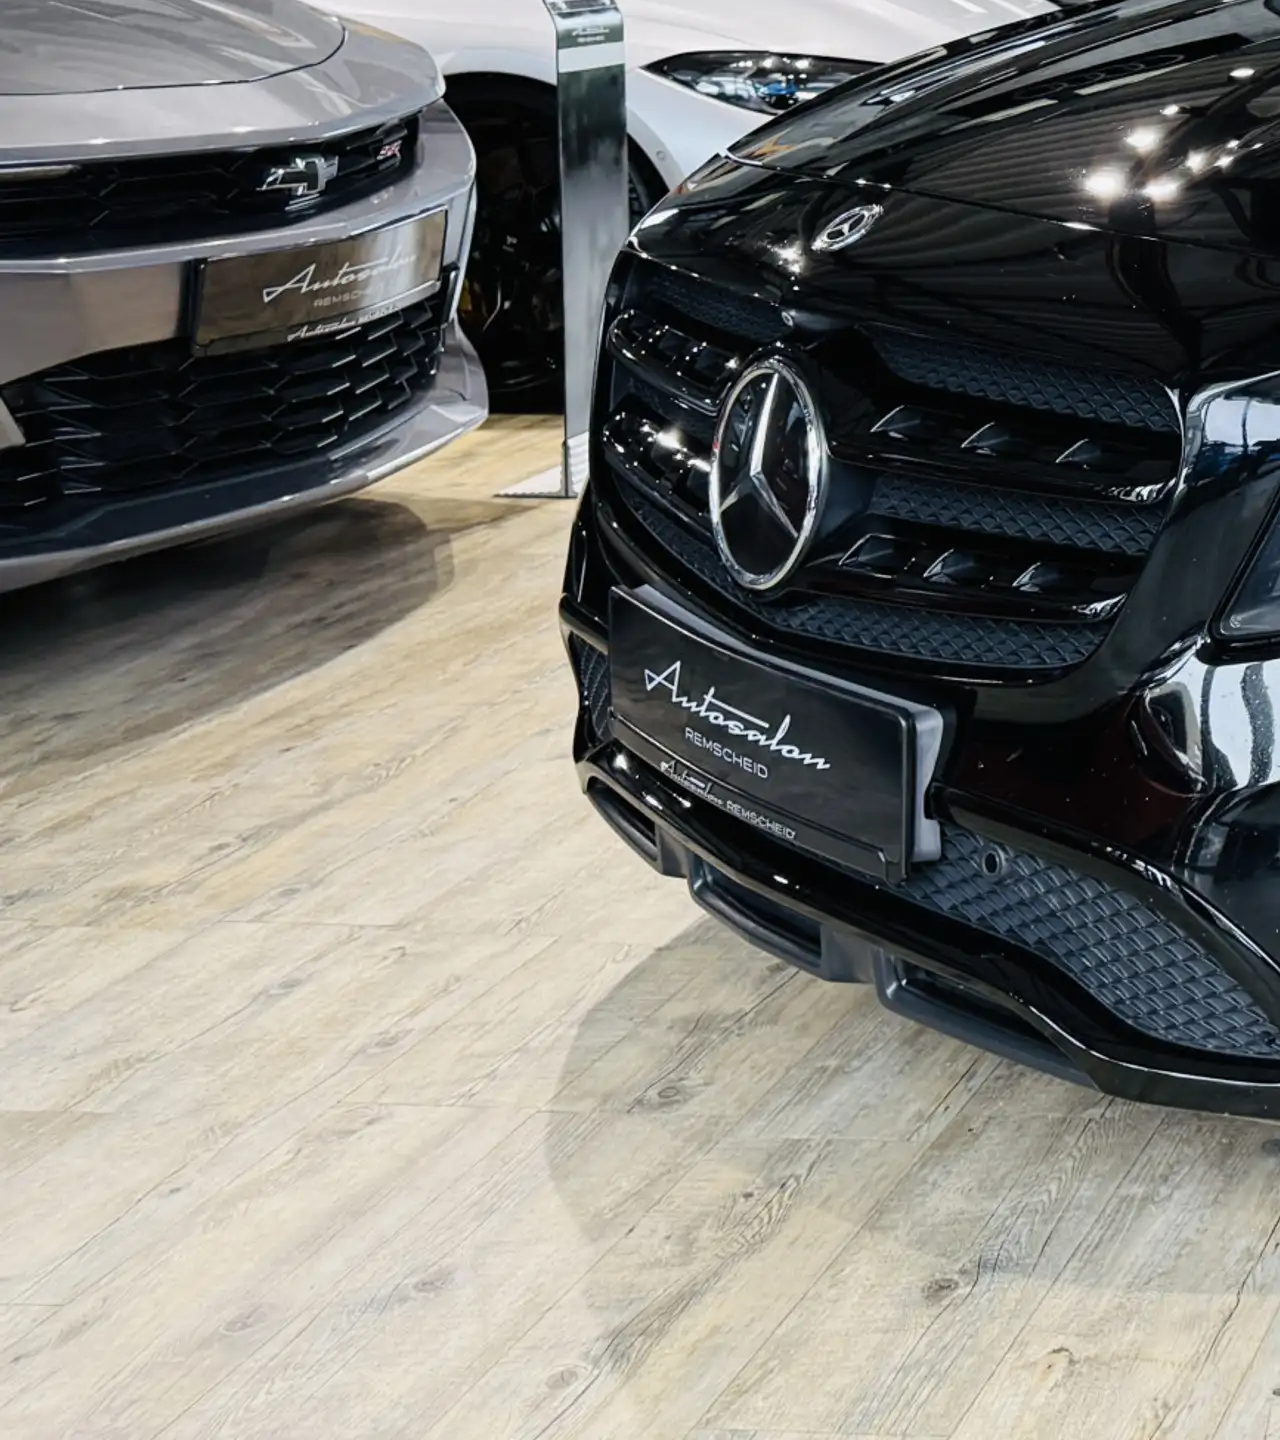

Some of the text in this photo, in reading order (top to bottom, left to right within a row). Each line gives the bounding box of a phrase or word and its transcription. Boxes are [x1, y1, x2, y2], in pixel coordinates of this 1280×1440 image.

[643, 660, 831, 771] Autosalon
[684, 726, 770, 779] REMSCHEID
[725, 799, 797, 841] REMSCHEID
